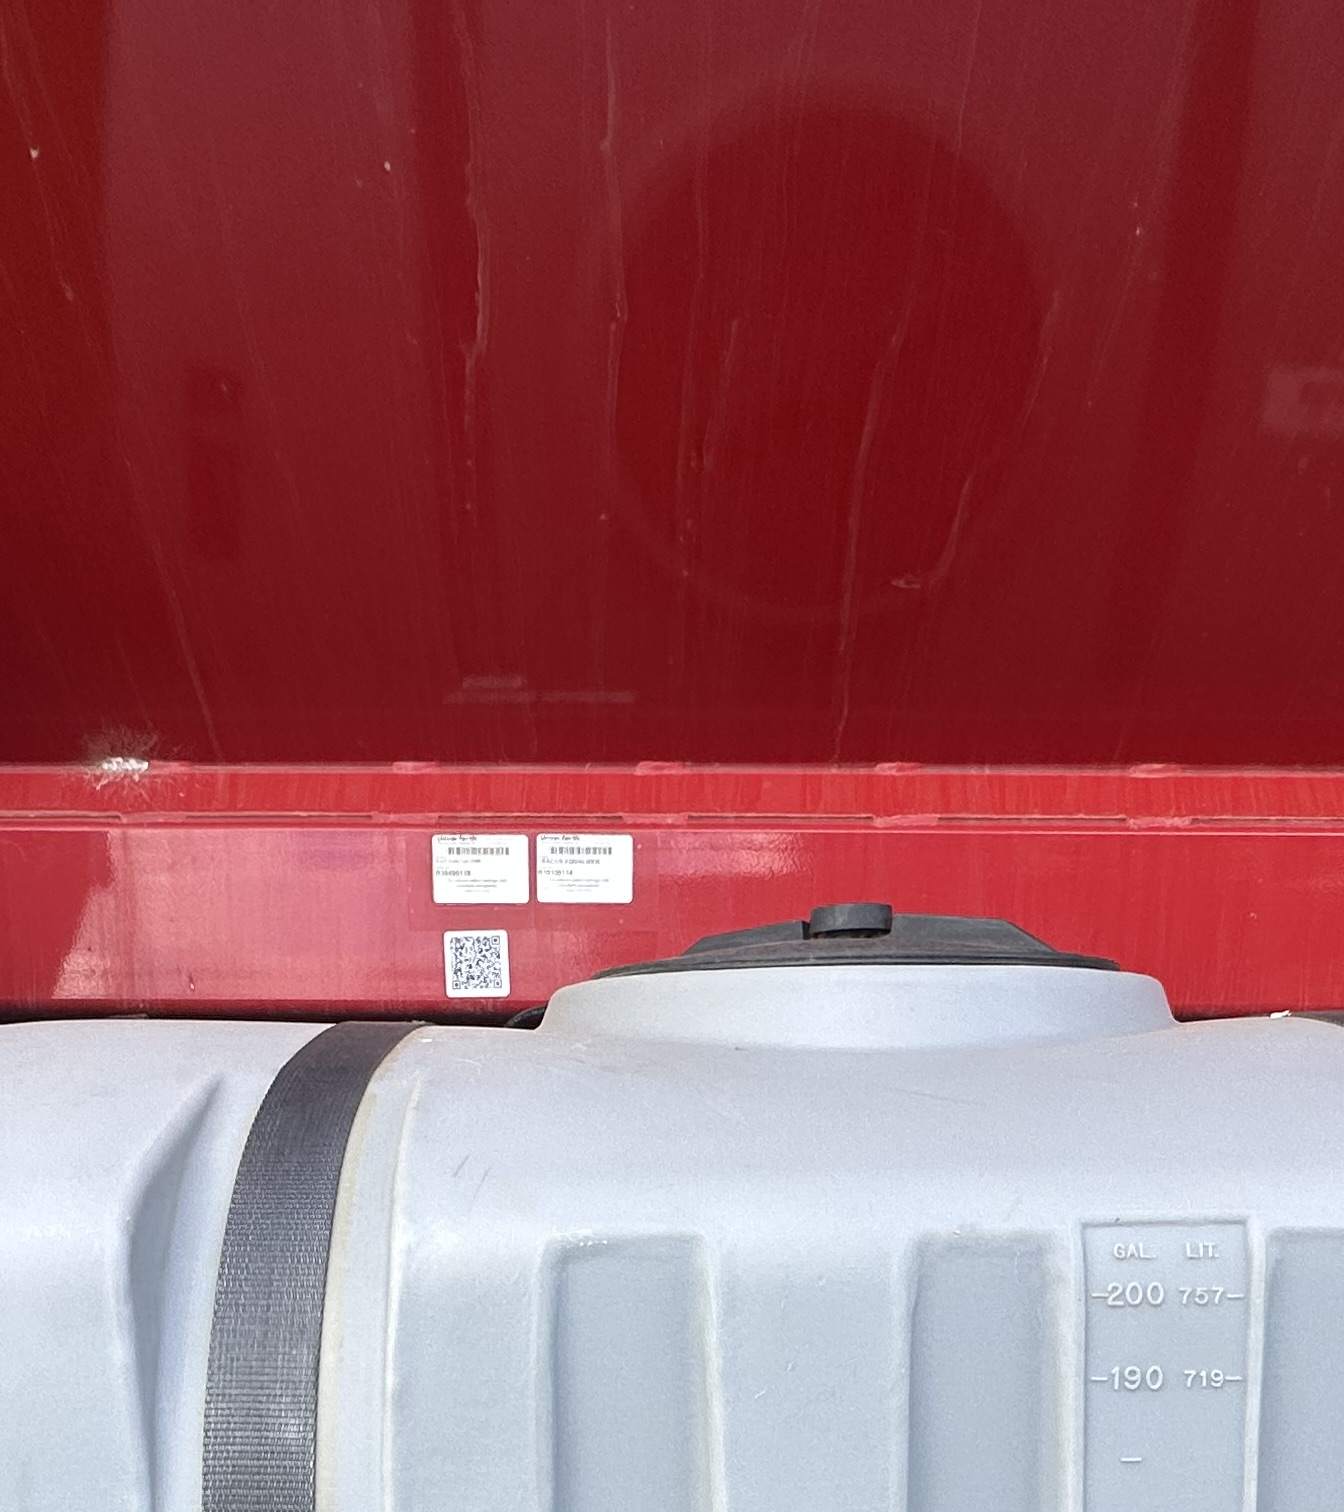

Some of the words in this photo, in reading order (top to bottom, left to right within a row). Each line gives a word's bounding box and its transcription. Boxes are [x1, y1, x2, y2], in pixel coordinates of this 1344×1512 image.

[1106, 1281, 1165, 1307] 200
[1178, 1287, 1224, 1306] 757
[1110, 1365, 1164, 1391] 190
[1182, 1369, 1225, 1389] 719
